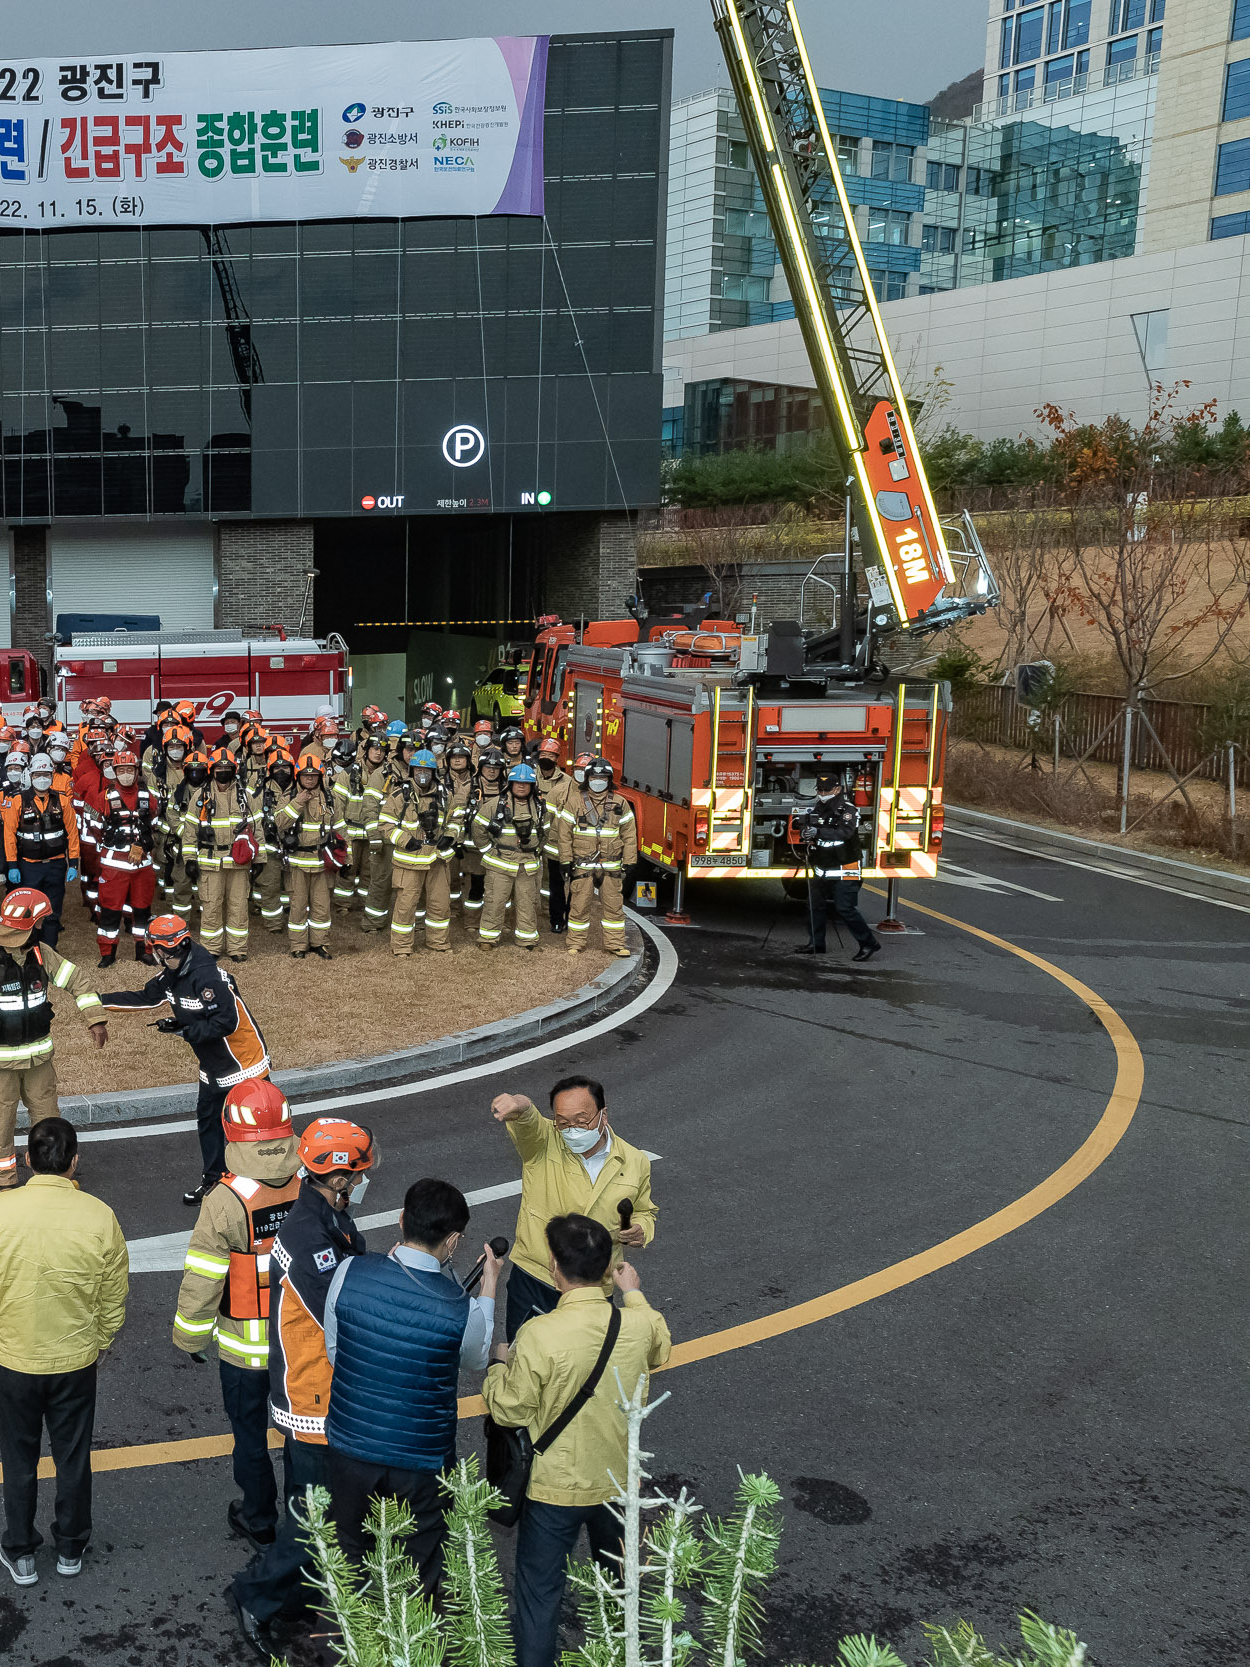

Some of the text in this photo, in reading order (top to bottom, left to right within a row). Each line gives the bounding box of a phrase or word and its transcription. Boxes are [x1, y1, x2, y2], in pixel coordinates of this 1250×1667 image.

[59, 61, 162, 100] 광진구
[370, 106, 415, 118] 광진구
[38, 119, 50, 178] /
[60, 115, 185, 179] 긴급구조
[196, 108, 324, 178] 종합훈련
[367, 132, 418, 145] 광진소방서
[449, 137, 480, 147] KOFIH
[367, 157, 419, 170] 광진경찰서
[433, 156, 475, 166] NECA
[38, 200, 65, 218] 11.
[75, 199, 103, 216] 15.
[112, 196, 145, 217] (화)
[377, 495, 405, 509] OUT
[436, 499, 467, 508] 제한높이
[521, 492, 535, 505] IN
[895, 528, 930, 584] 18M
[414, 672, 433, 704] SLOW
[720, 856, 743, 865] 4850
